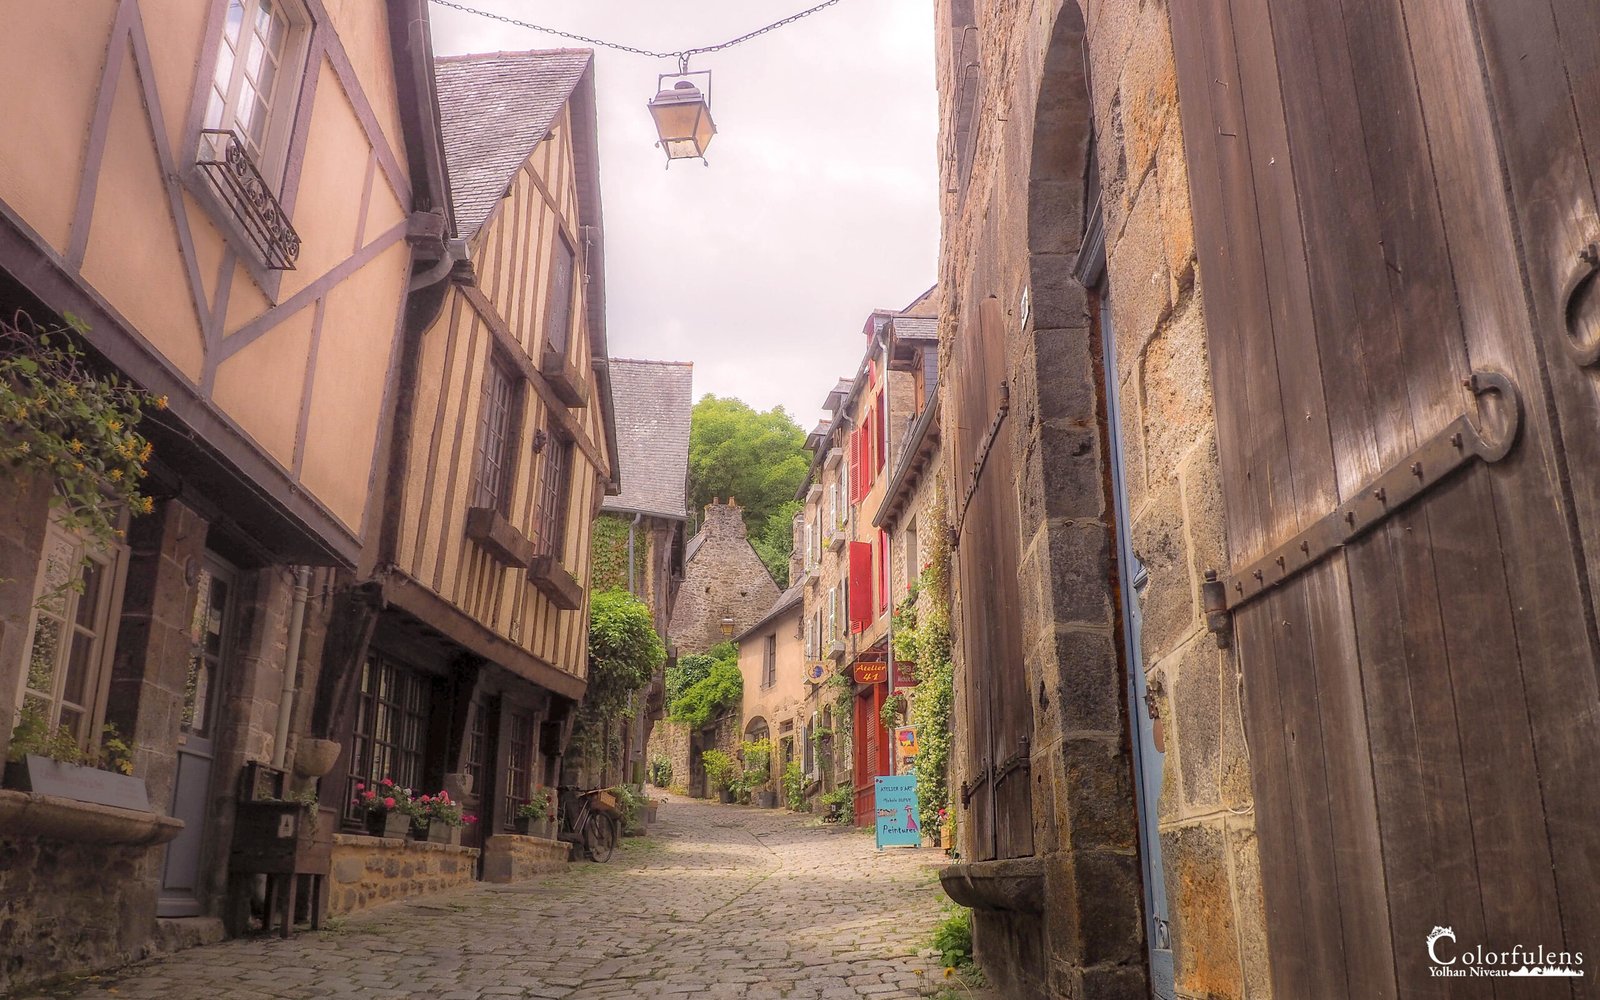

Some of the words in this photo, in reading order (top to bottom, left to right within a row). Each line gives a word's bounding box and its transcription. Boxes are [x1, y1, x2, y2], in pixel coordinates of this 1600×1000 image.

[856, 664, 885, 672] Atelier
[863, 673, 880, 681] 41
[882, 825, 916, 835] Peintures
